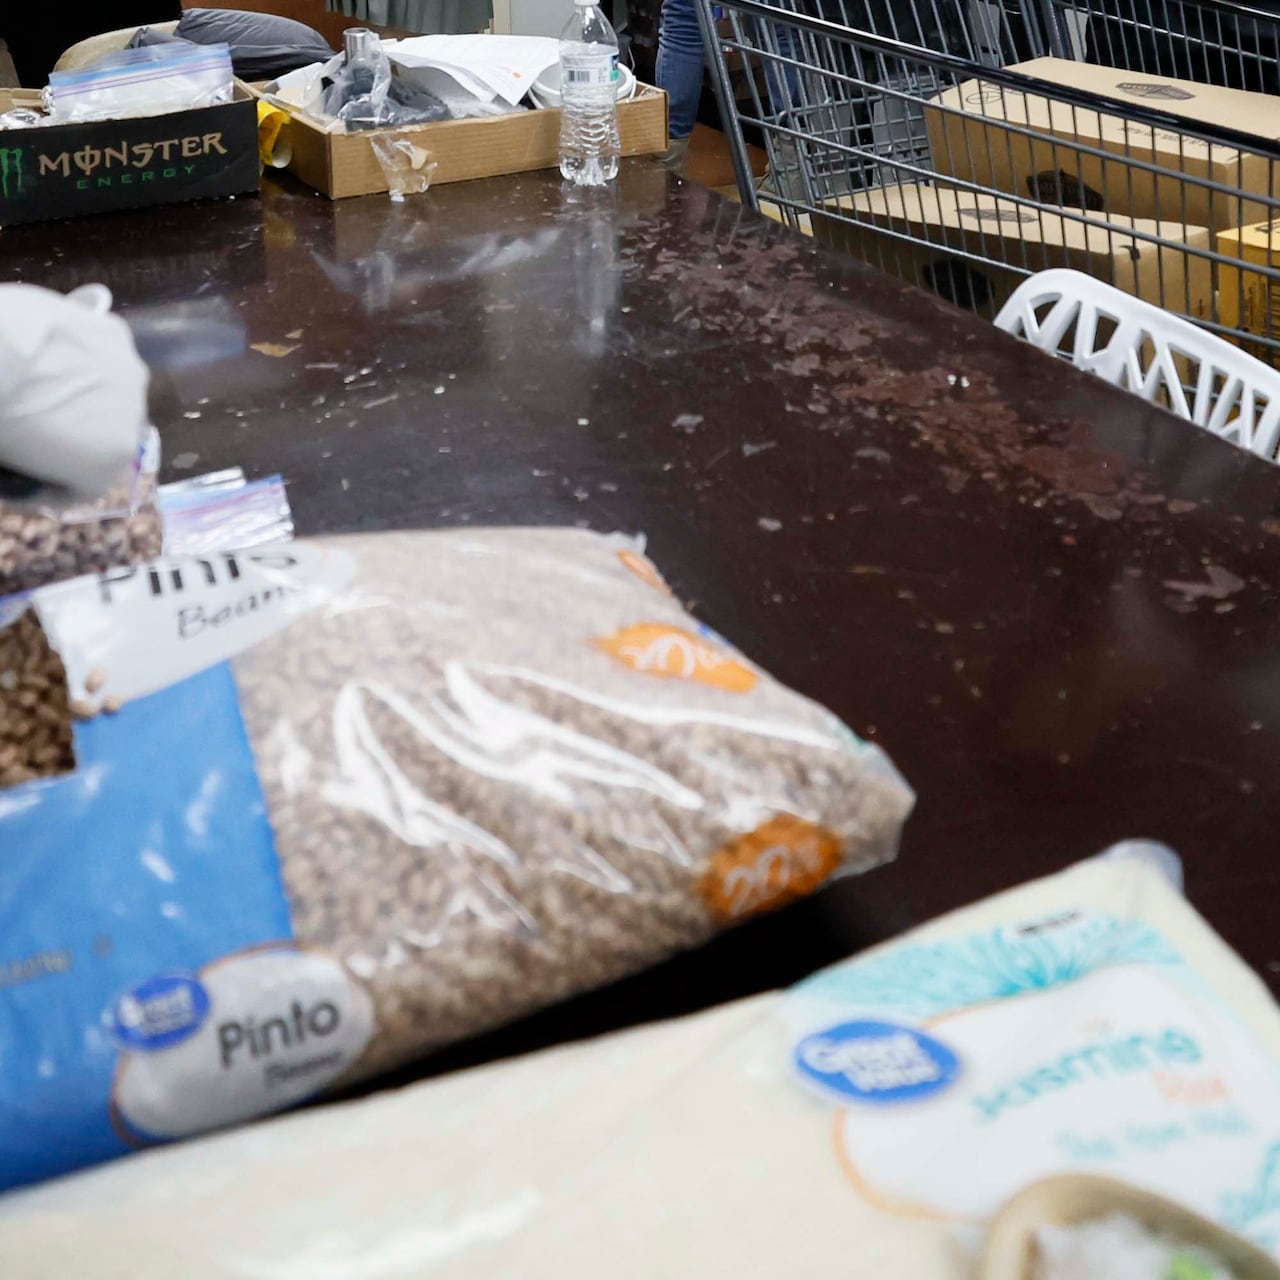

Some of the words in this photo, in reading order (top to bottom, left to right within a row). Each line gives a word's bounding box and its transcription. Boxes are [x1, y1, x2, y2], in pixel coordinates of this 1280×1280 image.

[38, 132, 228, 176] MONSTER
[76, 164, 196, 190] ENERGY
[218, 998, 339, 1070] Pinto
